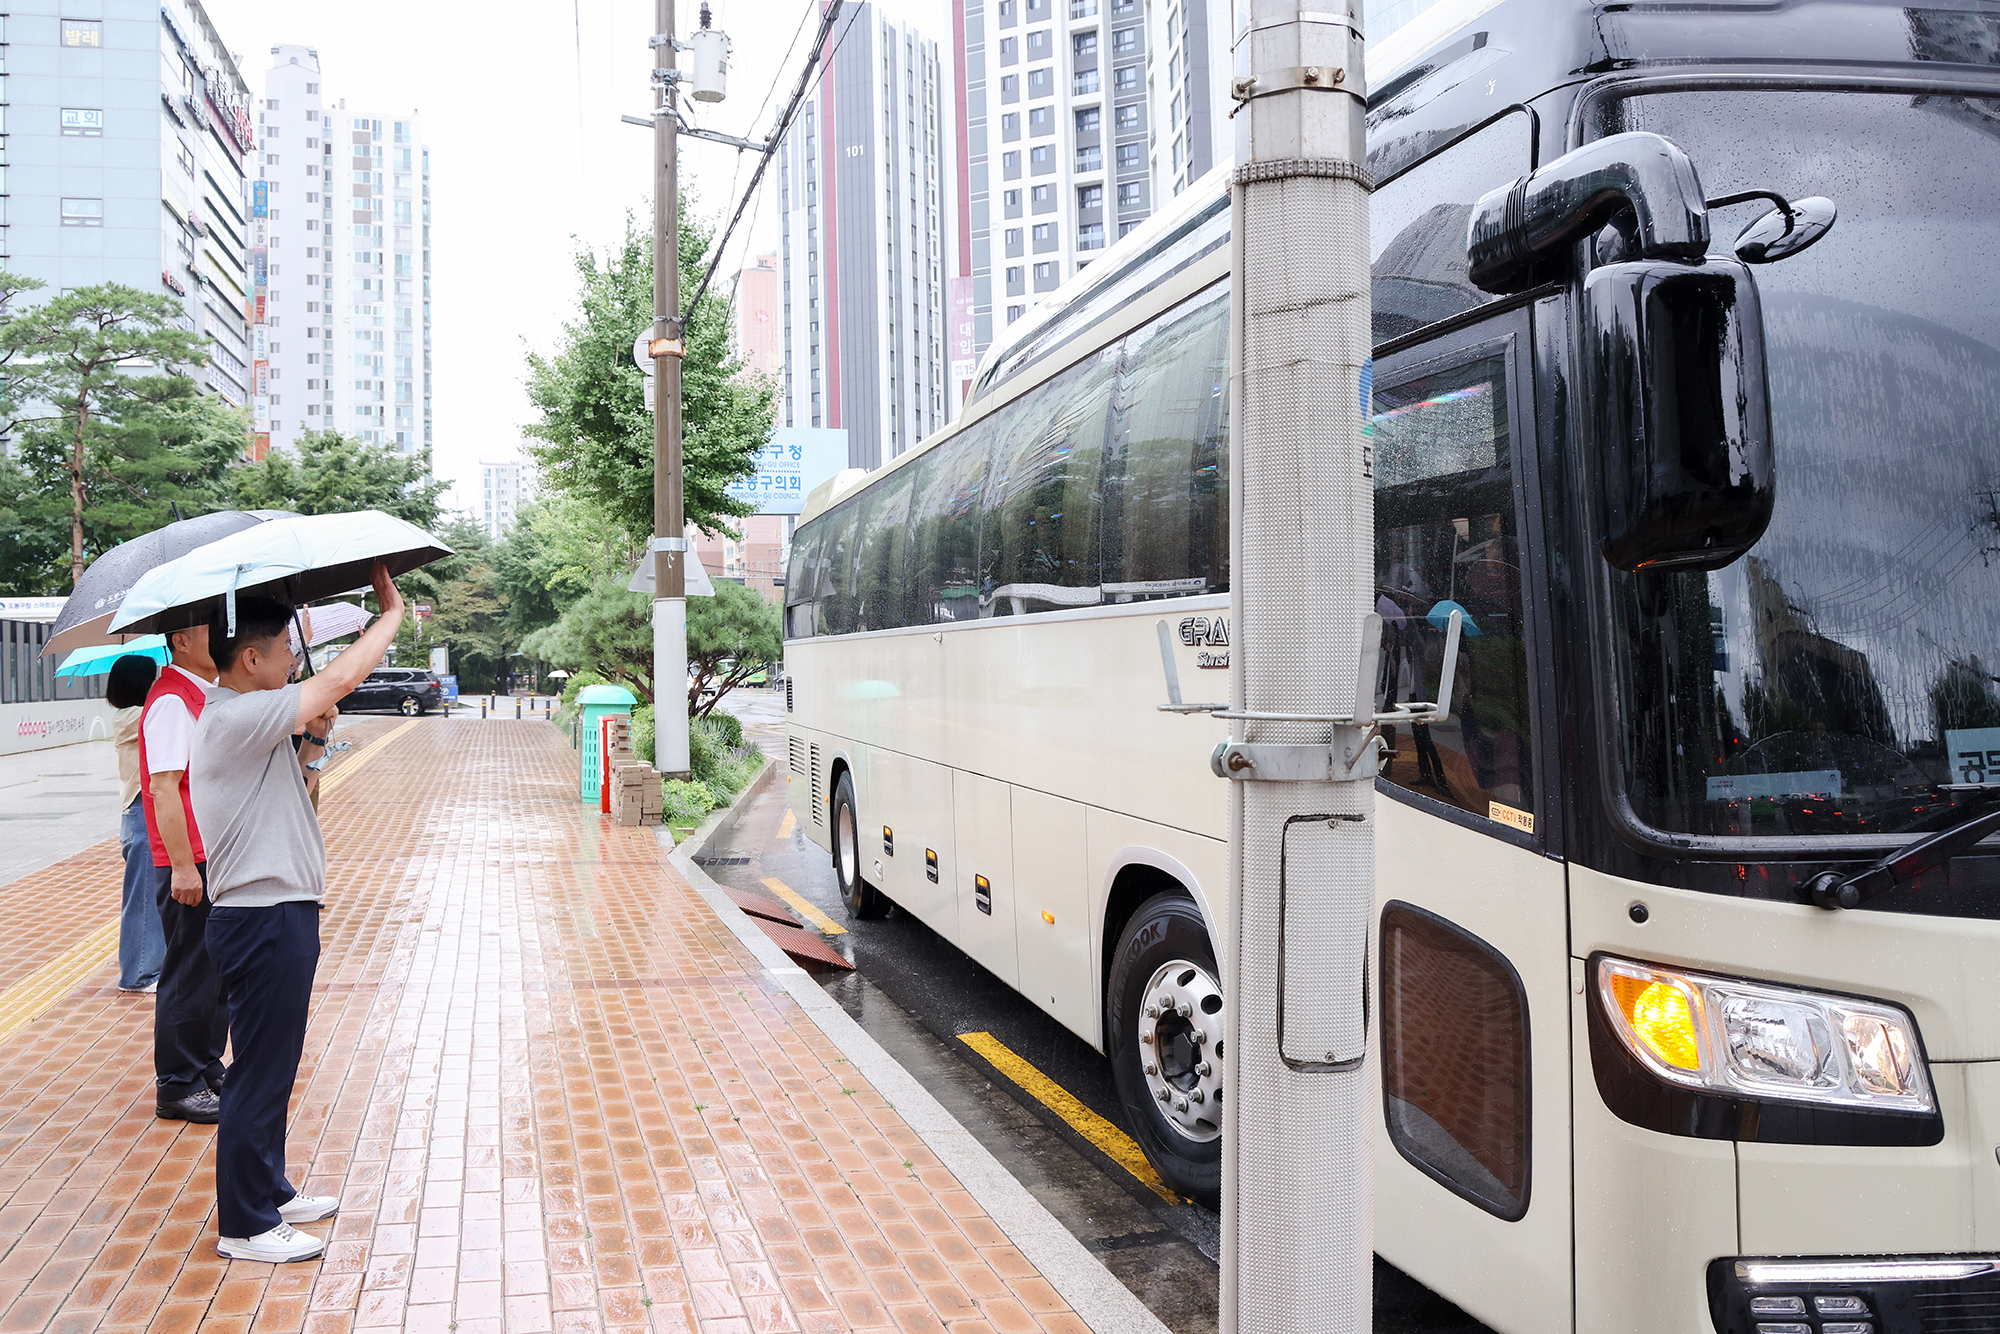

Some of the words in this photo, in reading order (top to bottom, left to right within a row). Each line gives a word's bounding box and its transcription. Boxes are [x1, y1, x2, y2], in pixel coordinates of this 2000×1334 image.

[65, 29, 99, 47] 발레
[64, 110, 99, 126] 교회
[845, 144, 864, 158] 101
[960, 322, 975, 337] 대
[778, 461, 800, 469] OFFICE
[731, 492, 772, 500] DOBONG-GU
[773, 492, 800, 500] COUNCIL
[1178, 616, 1231, 647] GRA
[18, 716, 48, 738] dobong
[1502, 809, 1518, 823] CCTV
[1518, 814, 1533, 829] 작동중
